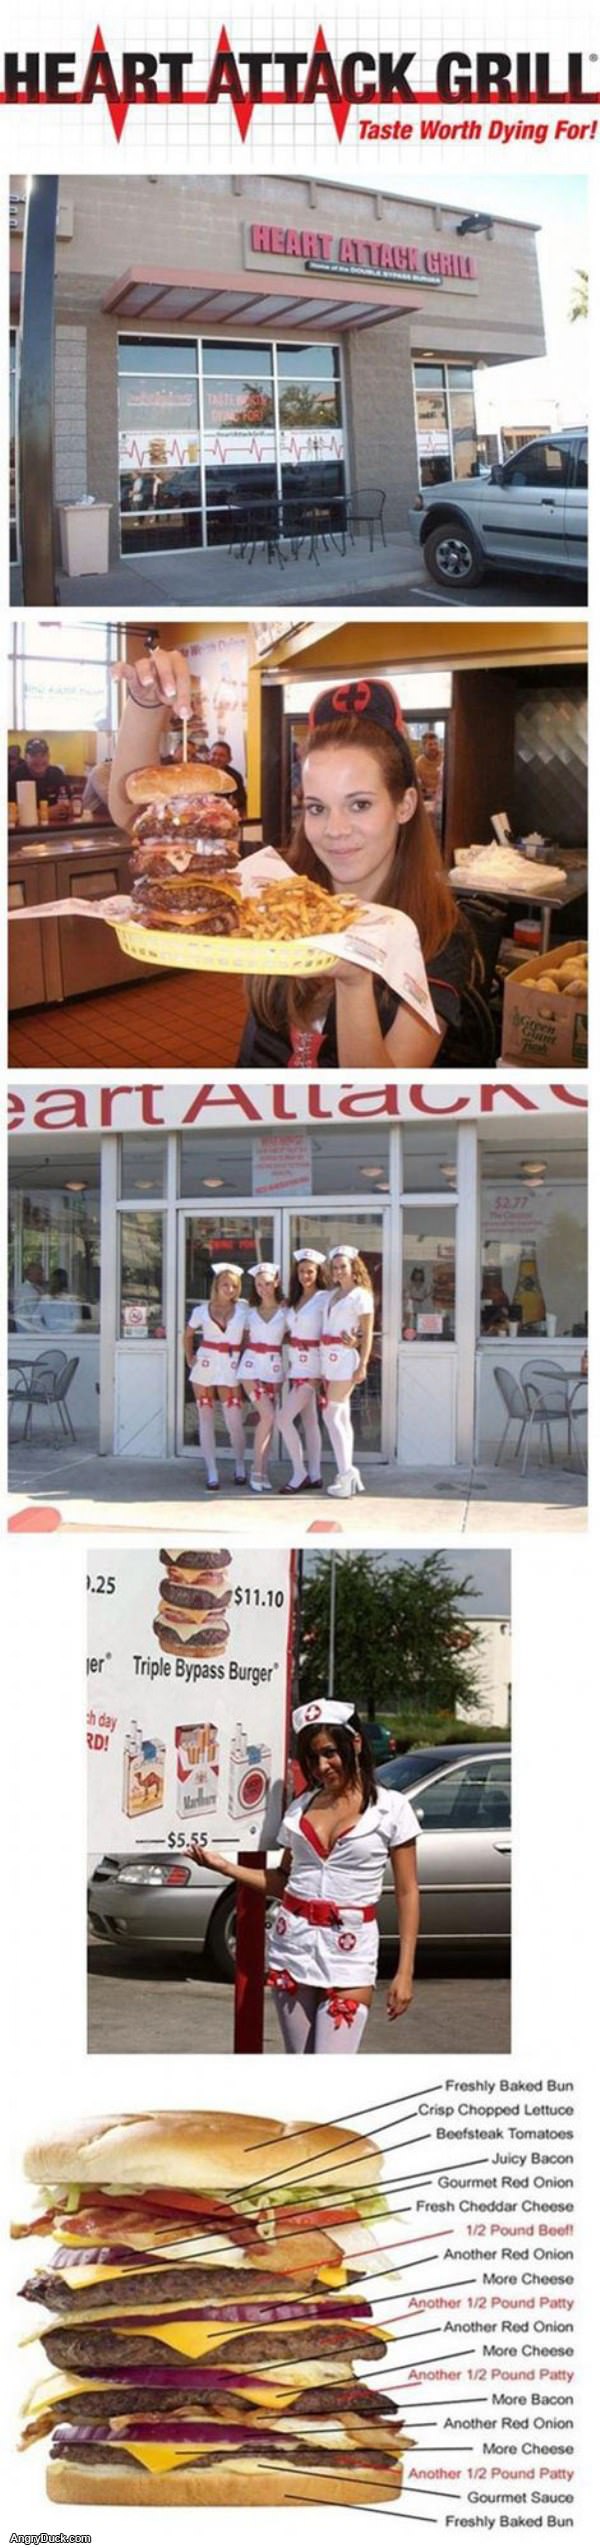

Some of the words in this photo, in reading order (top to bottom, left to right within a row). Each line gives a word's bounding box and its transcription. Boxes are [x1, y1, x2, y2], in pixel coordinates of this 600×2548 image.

[4, 52, 194, 104] HEART
[206, 52, 416, 104] ATTACK
[436, 51, 599, 104] GRILL
[358, 120, 413, 139] Taste
[420, 120, 482, 139] Worth
[488, 120, 549, 144] Dying
[555, 119, 598, 139] For!
[251, 224, 333, 260] HEART
[338, 237, 420, 272] ATTACK
[424, 250, 478, 280] GRILL
[86, 1574, 116, 1595] .25
[234, 1585, 284, 1608] $11.10
[86, 1657, 106, 1676] er
[132, 1654, 172, 1681] Triple
[175, 1657, 225, 1682] Bypass
[229, 1660, 272, 1686] Burger
[98, 1711, 118, 1733] day
[167, 1831, 209, 1848] $5.55
[445, 2080, 496, 2094] Freshly
[499, 2080, 543, 2092] Baked
[546, 2080, 574, 2092] Bun
[418, 2104, 455, 2117] Crisp
[457, 2104, 520, 2117] Chopped
[524, 2104, 575, 2116] Lettuce
[436, 2128, 504, 2140] Beefsteak
[509, 2128, 574, 2140] Tomatoes
[491, 2153, 527, 2167] Juicy
[530, 2152, 574, 2164] Bacon
[437, 2176, 498, 2189] Gourmet
[501, 2176, 530, 2188] Red
[533, 2176, 574, 2188] Onion
[416, 2200, 455, 2212] Fresh
[458, 2200, 518, 2212] Cheddar
[521, 2200, 575, 2212] Cheese
[467, 2224, 486, 2236] 1/2
[490, 2224, 535, 2236] Pound
[538, 2224, 574, 2236] Beef!
[443, 2248, 497, 2260] Another
[501, 2248, 530, 2260] Red
[533, 2248, 574, 2260] Onion
[482, 2273, 518, 2285] More
[521, 2273, 575, 2285] Cheese
[407, 2297, 462, 2309] Another
[467, 2297, 487, 2309] 1/2
[491, 2297, 535, 2309] Pound
[539, 2297, 574, 2311] Patty
[443, 2321, 497, 2333] Another
[501, 2321, 529, 2333] Red
[533, 2320, 574, 2333] Onion
[482, 2345, 518, 2357] More
[521, 2344, 575, 2357] Cheese
[408, 2369, 462, 2380] Another
[467, 2368, 487, 2380] 1/2
[491, 2369, 535, 2380] Pound
[539, 2369, 574, 2383] Patty
[491, 2394, 528, 2405] More
[531, 2393, 574, 2405] Bacon
[443, 2418, 498, 2429] Another
[501, 2417, 529, 2429] Red
[533, 2417, 574, 2429] Onion
[482, 2443, 518, 2454] More
[521, 2443, 575, 2455] Cheese
[408, 2468, 462, 2479] Another
[467, 2468, 487, 2479] 1/2
[491, 2467, 535, 2479] Pound
[539, 2468, 575, 2482] Patty
[467, 2491, 527, 2504] Gourmet
[530, 2491, 575, 2503] Sauce
[445, 2515, 496, 2530] Freshly
[499, 2515, 543, 2527] Baked
[546, 2515, 574, 2527] Bun
